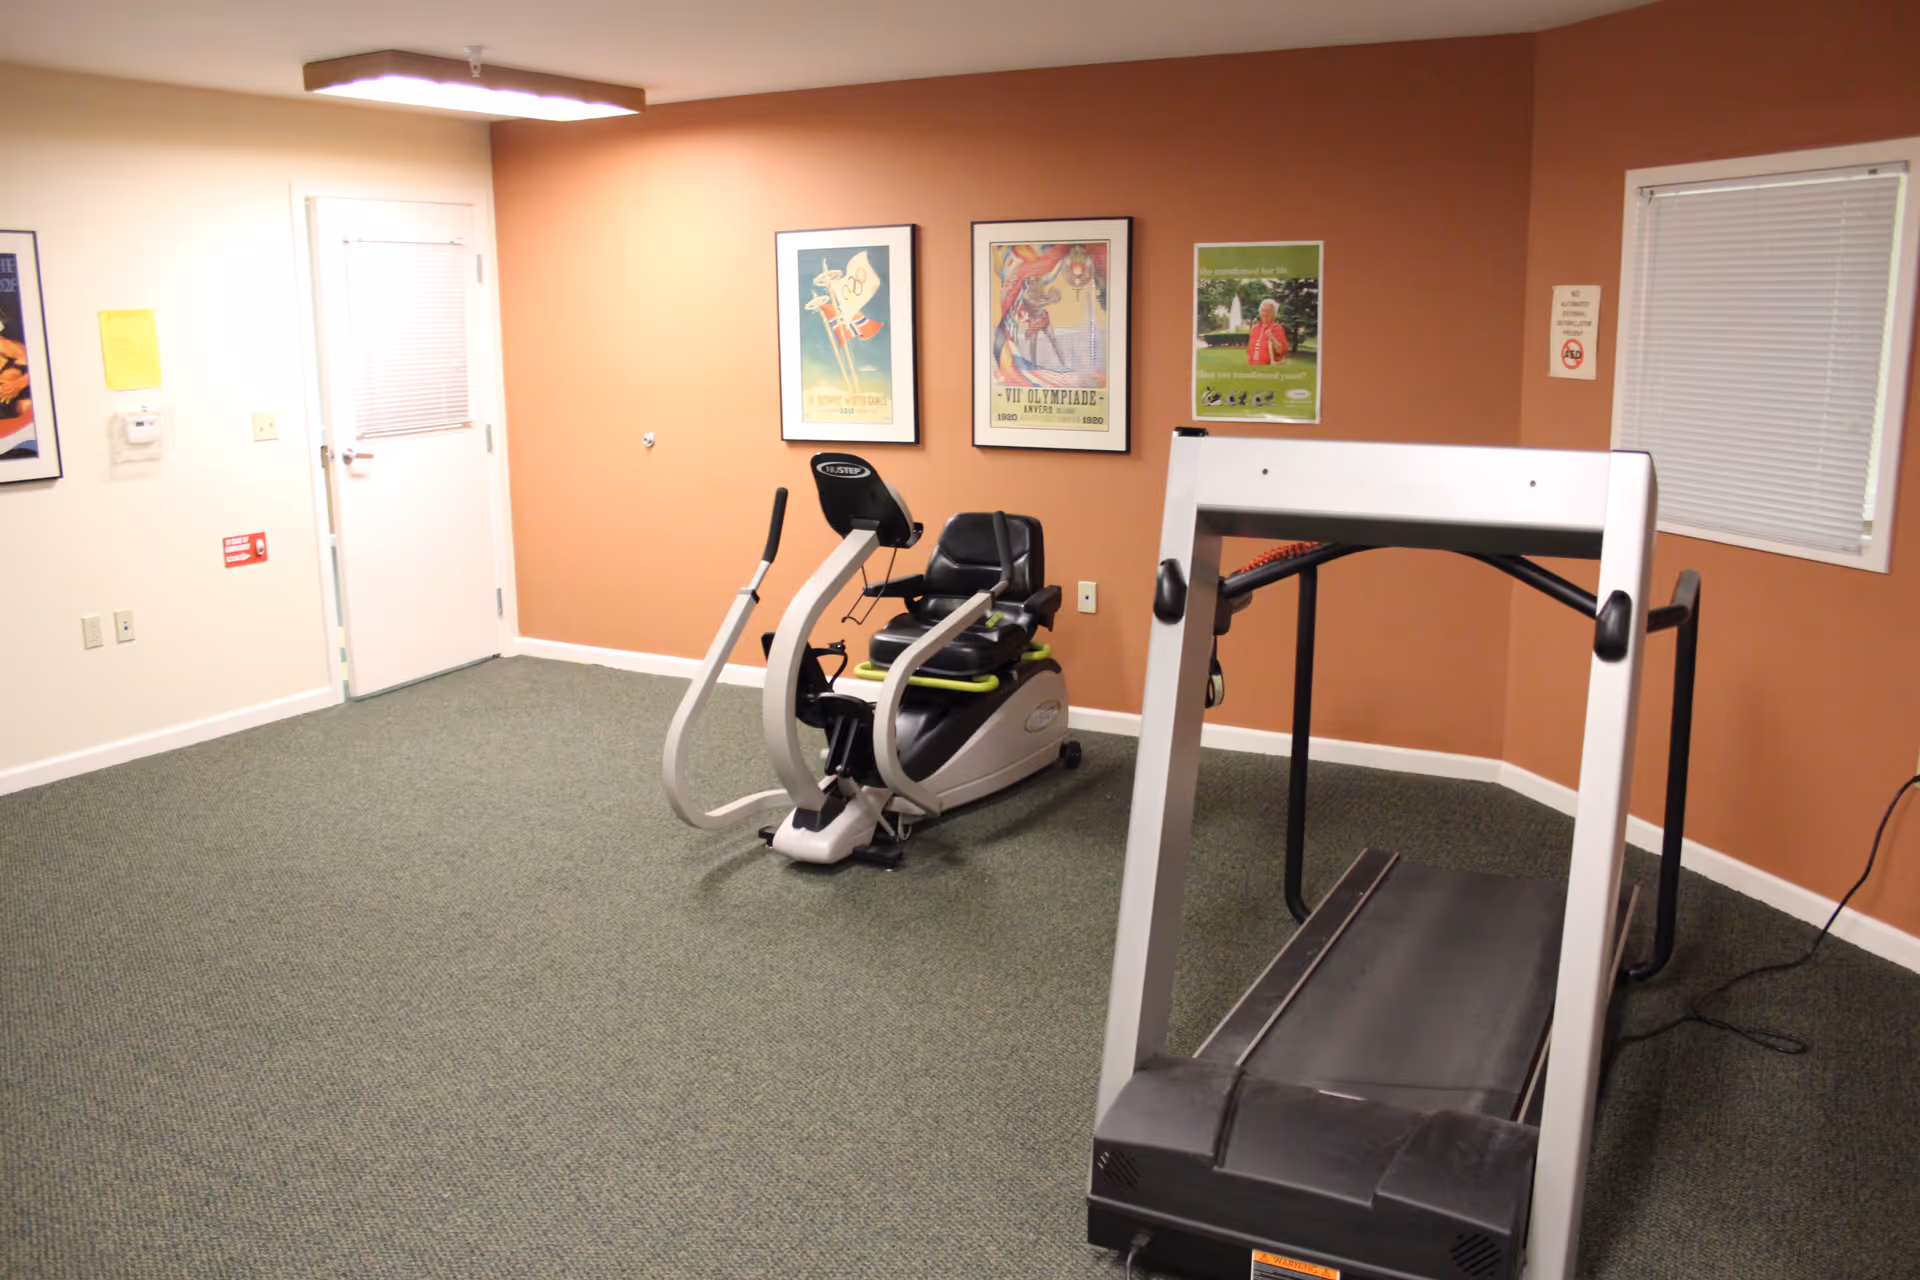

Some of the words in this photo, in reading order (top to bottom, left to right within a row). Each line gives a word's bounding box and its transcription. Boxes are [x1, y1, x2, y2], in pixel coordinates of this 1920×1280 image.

[1564, 350, 1581, 360] AED
[1027, 389, 1097, 406] OLYMPIADE
[1024, 405, 1053, 414] ANVERS
[997, 413, 1018, 421] 1920
[1082, 416, 1104, 425] 1920
[1273, 1256, 1318, 1273] WARNING
